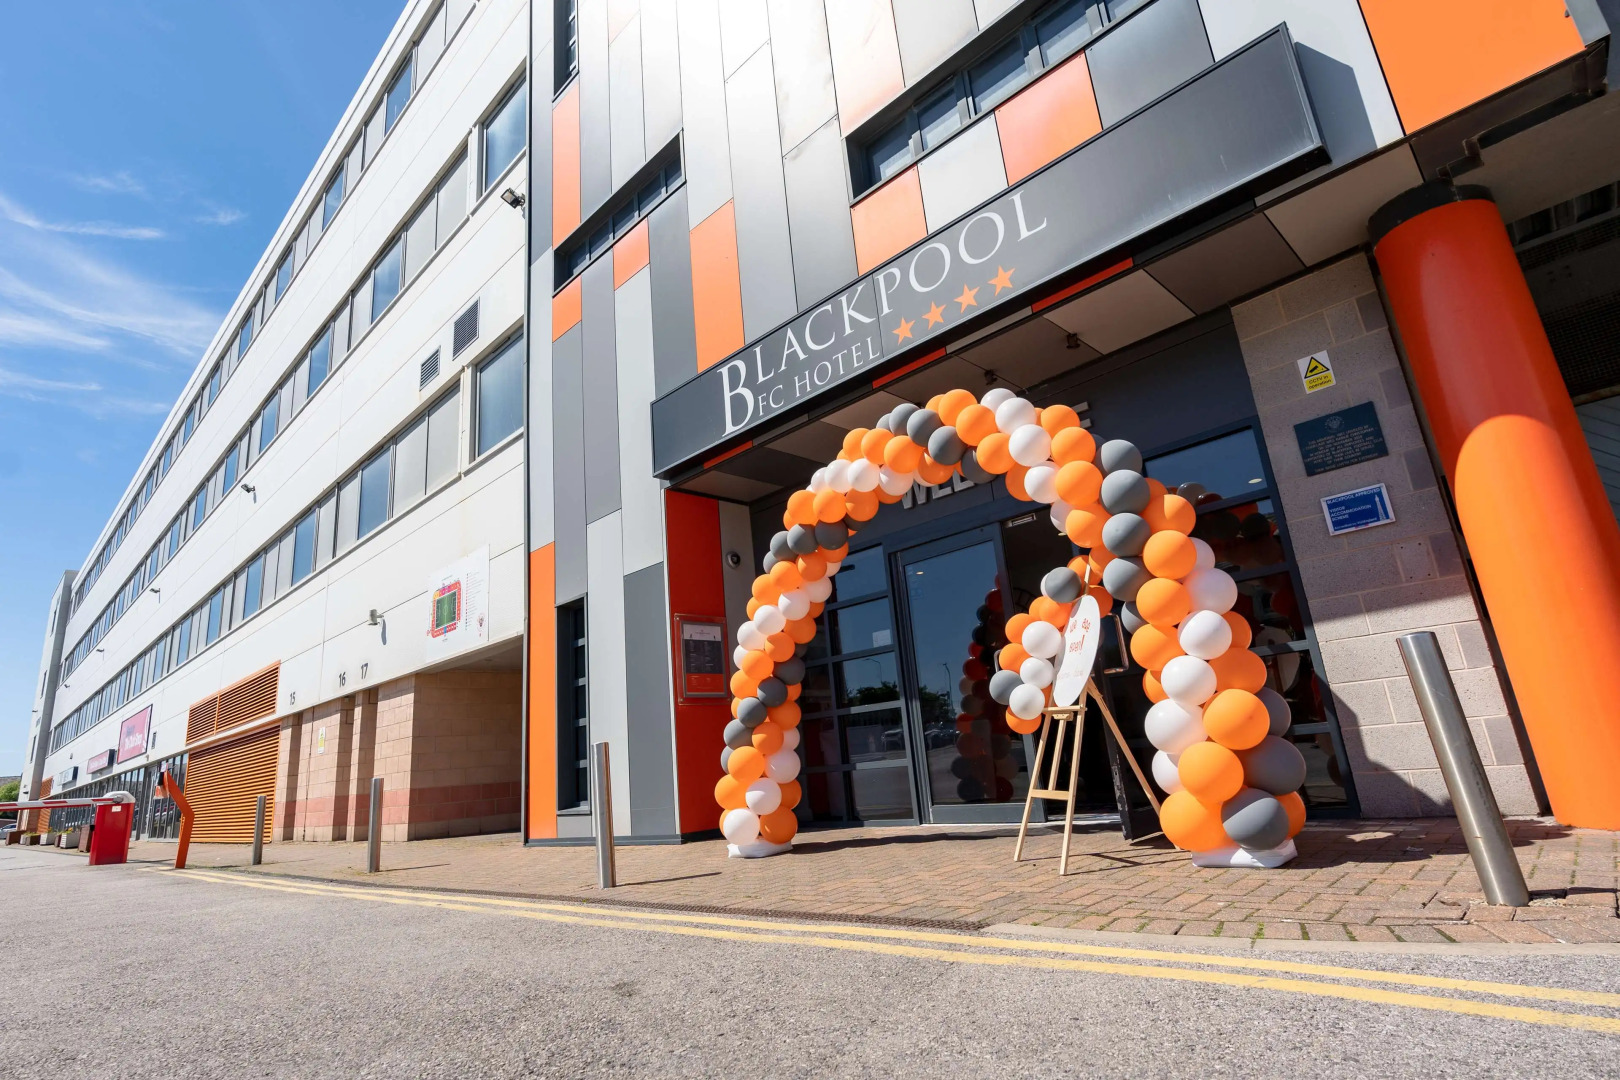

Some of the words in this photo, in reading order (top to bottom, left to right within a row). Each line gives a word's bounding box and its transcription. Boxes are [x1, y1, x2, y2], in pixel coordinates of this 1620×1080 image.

[716, 190, 1048, 438] BLACKPOOL
[758, 384, 785, 417] FC
[793, 336, 880, 398] HOTEL
[1309, 380, 1332, 389] operation
[1327, 494, 1355, 505] BLACKPOOL
[1355, 488, 1381, 497] APPROVED
[1331, 504, 1372, 517] ACCOMMODATION
[361, 663, 369, 680] 17
[339, 672, 346, 688] 16
[290, 692, 296, 706] 15
